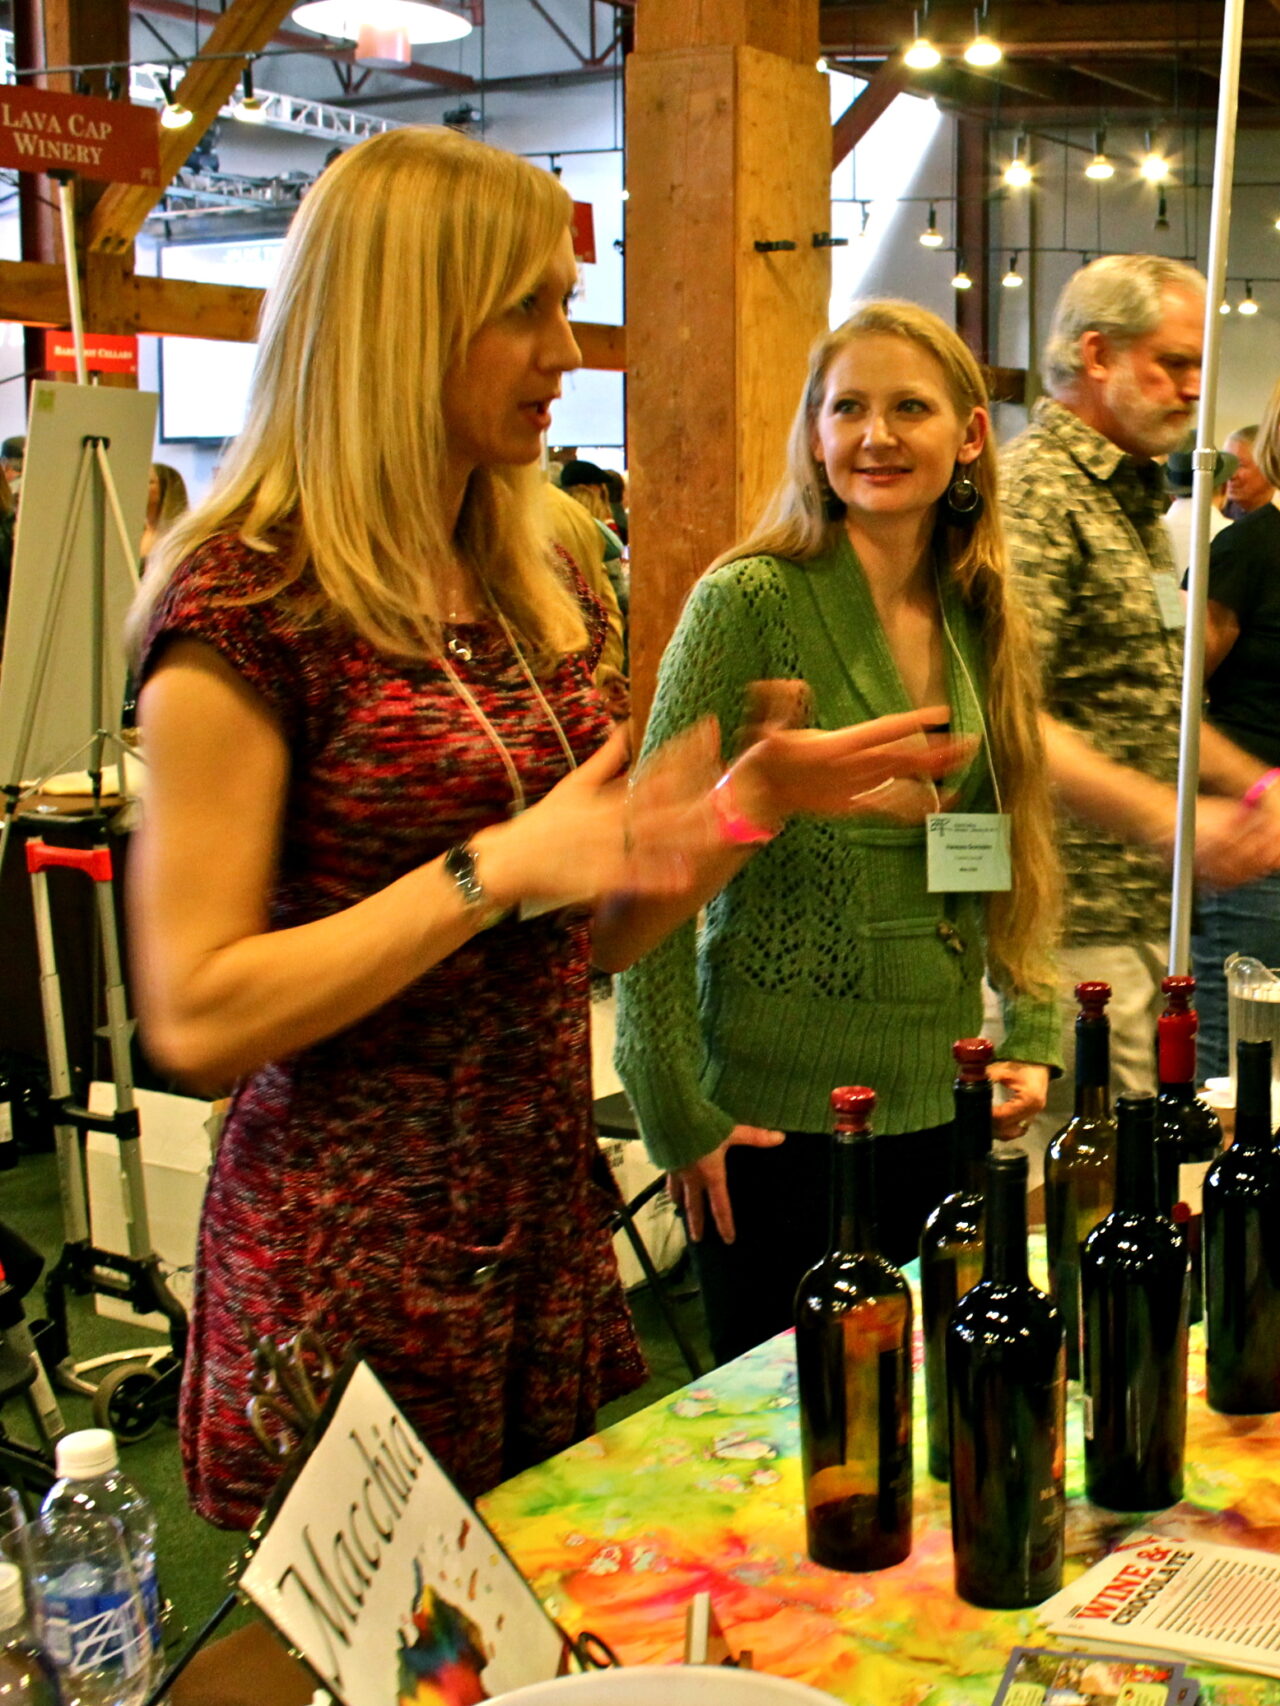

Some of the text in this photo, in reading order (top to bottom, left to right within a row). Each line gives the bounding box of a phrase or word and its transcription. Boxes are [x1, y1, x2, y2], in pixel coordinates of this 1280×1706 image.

[2, 103, 112, 140] LAVA CAP
[13, 132, 103, 164] WINERY
[277, 1415, 423, 1690] Macchia
[1074, 1563, 1155, 1619] WINE
[1136, 1546, 1173, 1562] &
[1111, 1549, 1195, 1625] CHOCOLATE
